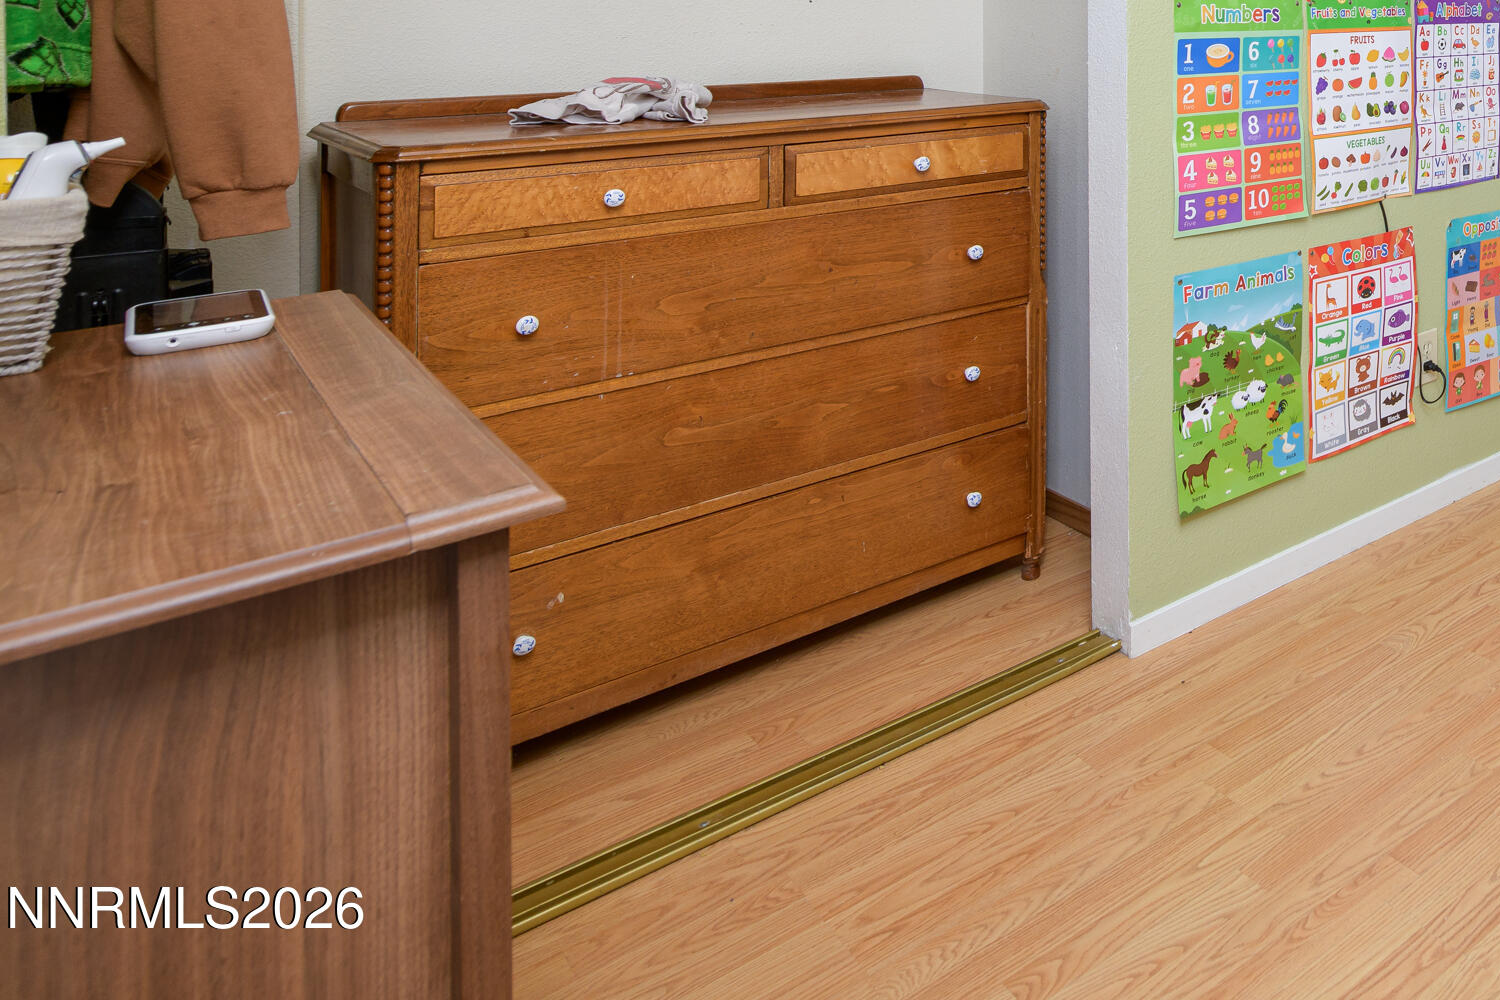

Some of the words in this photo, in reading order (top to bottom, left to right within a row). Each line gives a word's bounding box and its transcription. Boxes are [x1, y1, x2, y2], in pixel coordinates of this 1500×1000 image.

[1201, 3, 1280, 25] Numbers
[1311, 6, 1338, 19] Fruits
[1340, 6, 1356, 18] and
[1360, 7, 1406, 19] Vegetables
[1436, 2, 1482, 18] Alphabet
[1350, 35, 1375, 45] FRUITS
[1184, 43, 1194, 64] 1
[1248, 41, 1259, 61] 6
[1183, 83, 1194, 104] 2
[1248, 79, 1258, 99] 7
[1182, 121, 1195, 141] 3
[1248, 115, 1259, 135] 8
[1346, 136, 1386, 149] VEGETABLES
[1183, 160, 1197, 181] 4
[1250, 152, 1261, 172] 9
[1248, 188, 1269, 210] 10
[1184, 199, 1197, 220] 5
[1342, 243, 1388, 266] Colors
[1182, 282, 1229, 304] Farm
[1235, 265, 1296, 292] Animals
[1321, 310, 1343, 320] Orange
[1361, 302, 1373, 310] Red
[1388, 333, 1406, 343] Purple
[1323, 353, 1340, 362] Green
[1383, 373, 1406, 383] Rainbow
[1354, 384, 1371, 394] Brown
[1387, 414, 1400, 423] Black
[1266, 427, 1284, 436] rooster
[1247, 472, 1265, 482] donkey
